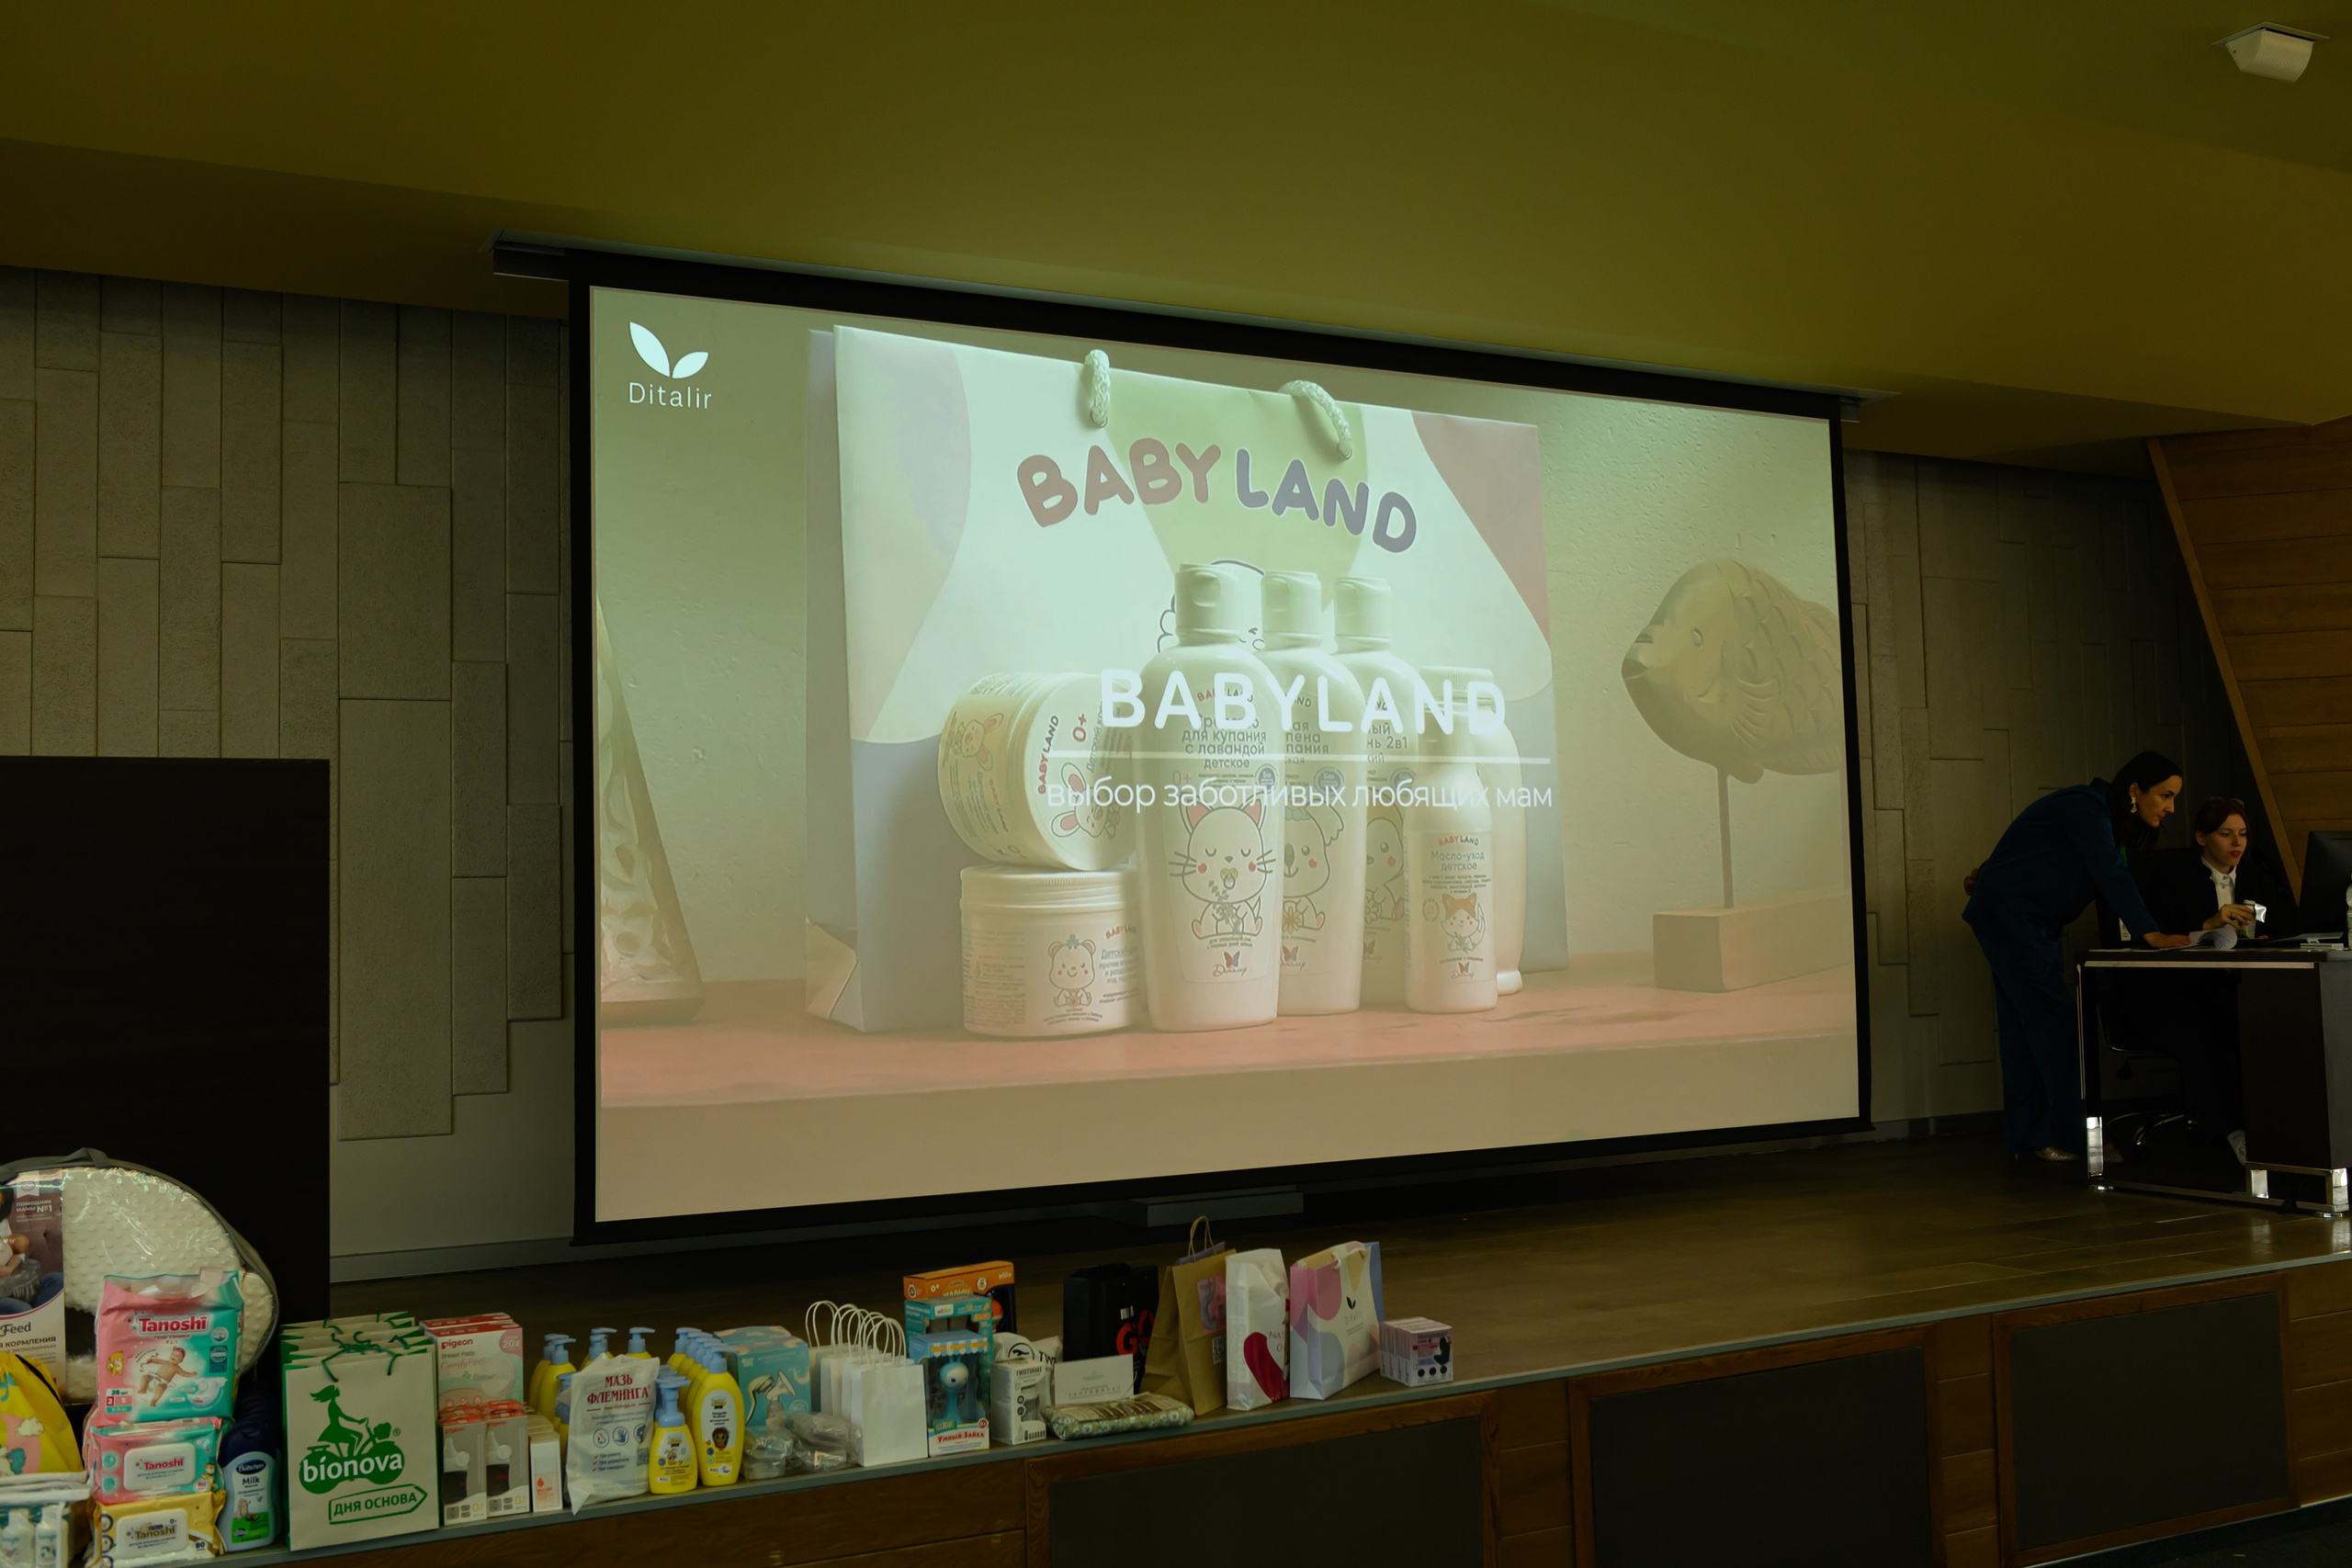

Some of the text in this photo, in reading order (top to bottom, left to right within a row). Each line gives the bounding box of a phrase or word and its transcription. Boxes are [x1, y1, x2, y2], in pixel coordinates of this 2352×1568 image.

[628, 381, 712, 410] Ditalir
[1017, 437, 1417, 554] BABY LAND
[1101, 669, 1506, 735] BABYLAND
[1182, 730, 1267, 745] для купания
[1198, 742, 1265, 758] лавандой
[1204, 759, 1250, 770] детское
[1047, 775, 1156, 814] выбор
[1163, 776, 1346, 807] заботливых
[1351, 778, 1489, 811] любящих
[1496, 787, 1552, 807] мам
[1430, 851, 1486, 862] Масло-уход
[1441, 863, 1477, 873] детское
[6, 1336, 57, 1348] КОРМЛЕНИЯ
[605, 1373, 633, 1388] МАЗЬ
[586, 1386, 649, 1404] ФЛЕМИНГА
[302, 1452, 403, 1483] bionova
[243, 1476, 260, 1485] Milk
[334, 1493, 417, 1517] ДНЯ ОСНОВА
